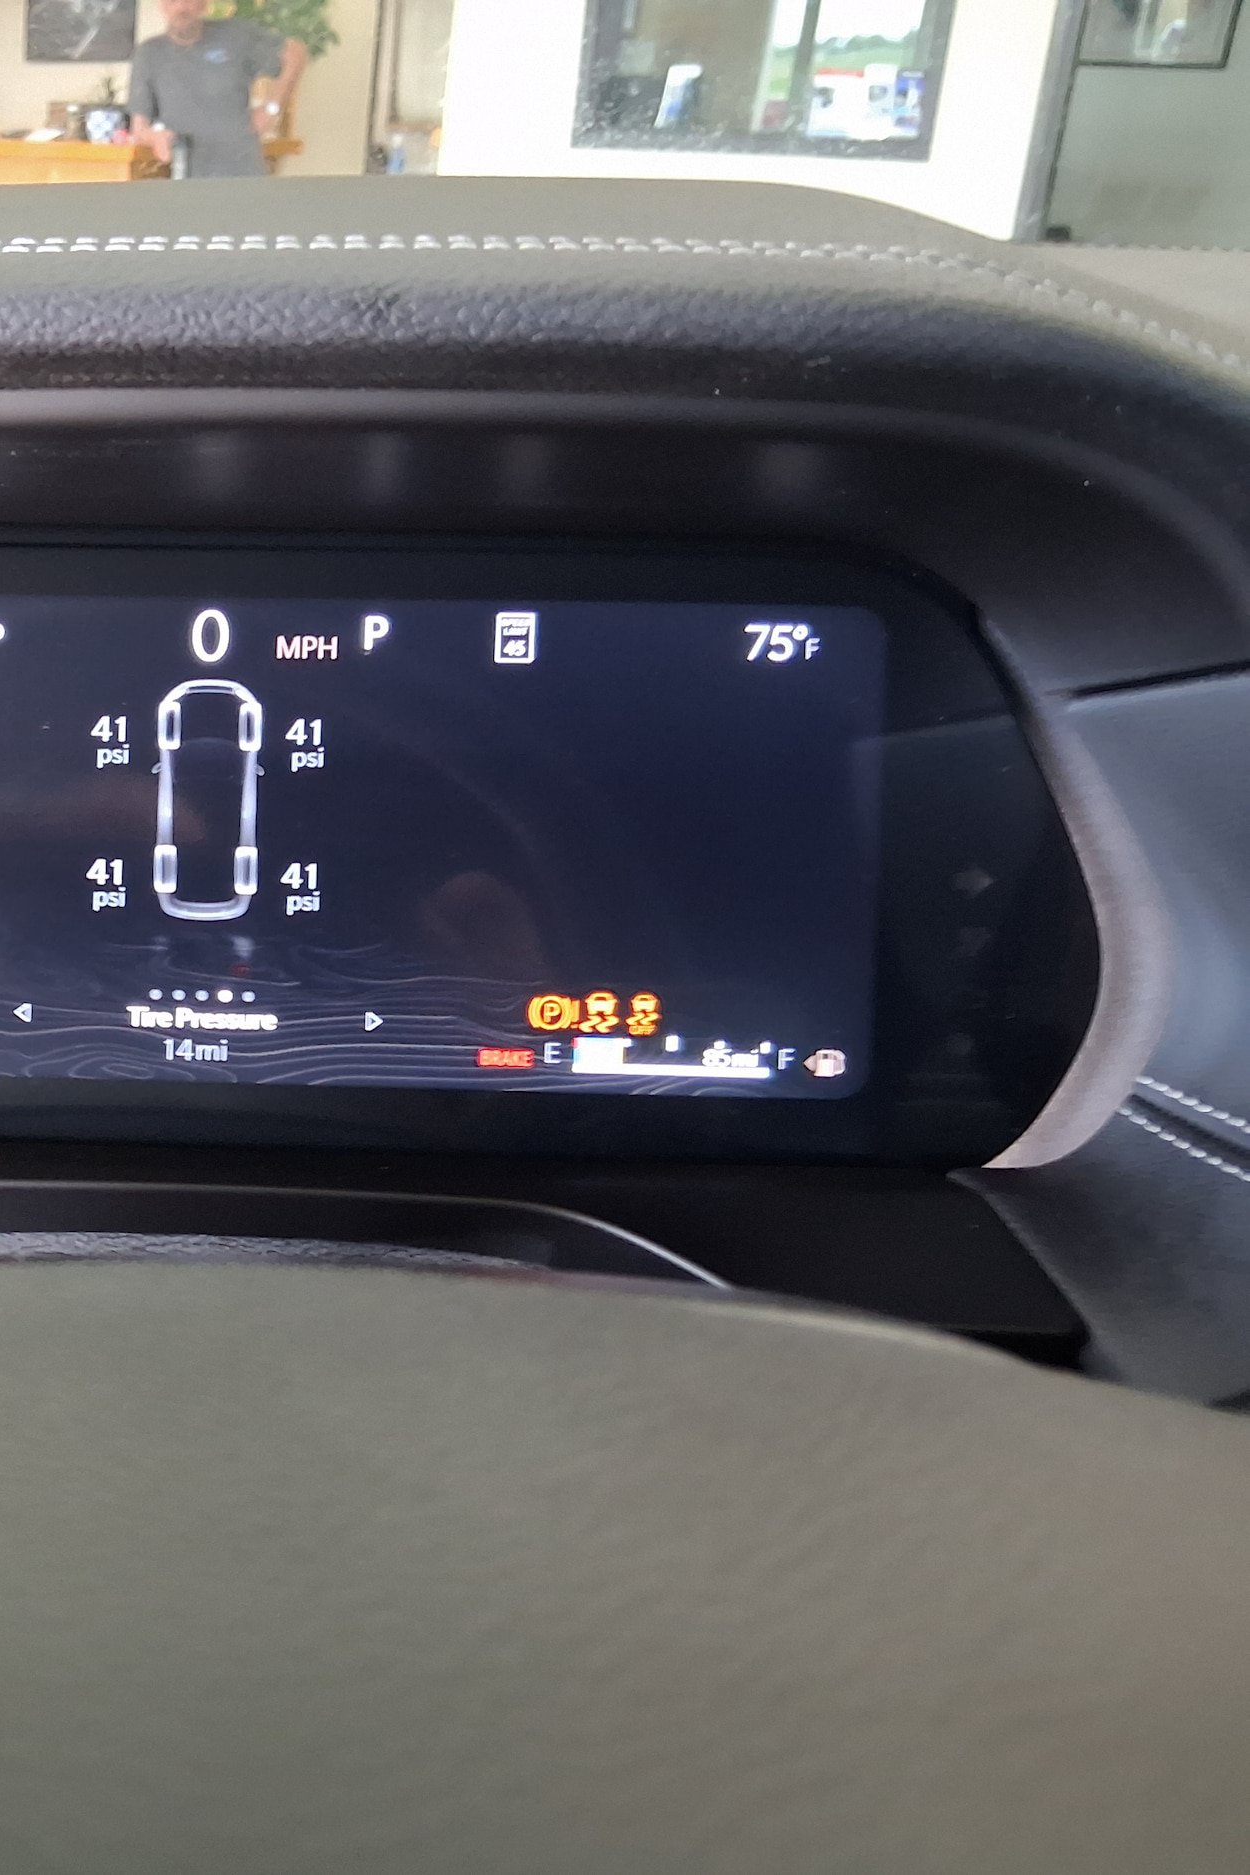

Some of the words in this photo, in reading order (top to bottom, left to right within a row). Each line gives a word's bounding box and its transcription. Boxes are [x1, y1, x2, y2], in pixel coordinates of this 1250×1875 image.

[191, 608, 230, 663] 0
[362, 614, 390, 651] P
[275, 634, 339, 660] MPH
[502, 639, 527, 657] 45
[90, 715, 127, 743] 41
[285, 718, 322, 746] 41
[96, 743, 130, 769] psi
[290, 746, 325, 772] psi
[86, 858, 123, 886] 41
[280, 862, 318, 890] 41
[92, 886, 127, 912] psi
[286, 891, 321, 916] psi
[125, 1004, 174, 1029] Tire
[174, 1006, 279, 1031] Pressure
[543, 1002, 562, 1023] P
[478, 1048, 535, 1068] BRAKE
[543, 1041, 562, 1064] E
[777, 1047, 797, 1070] F
